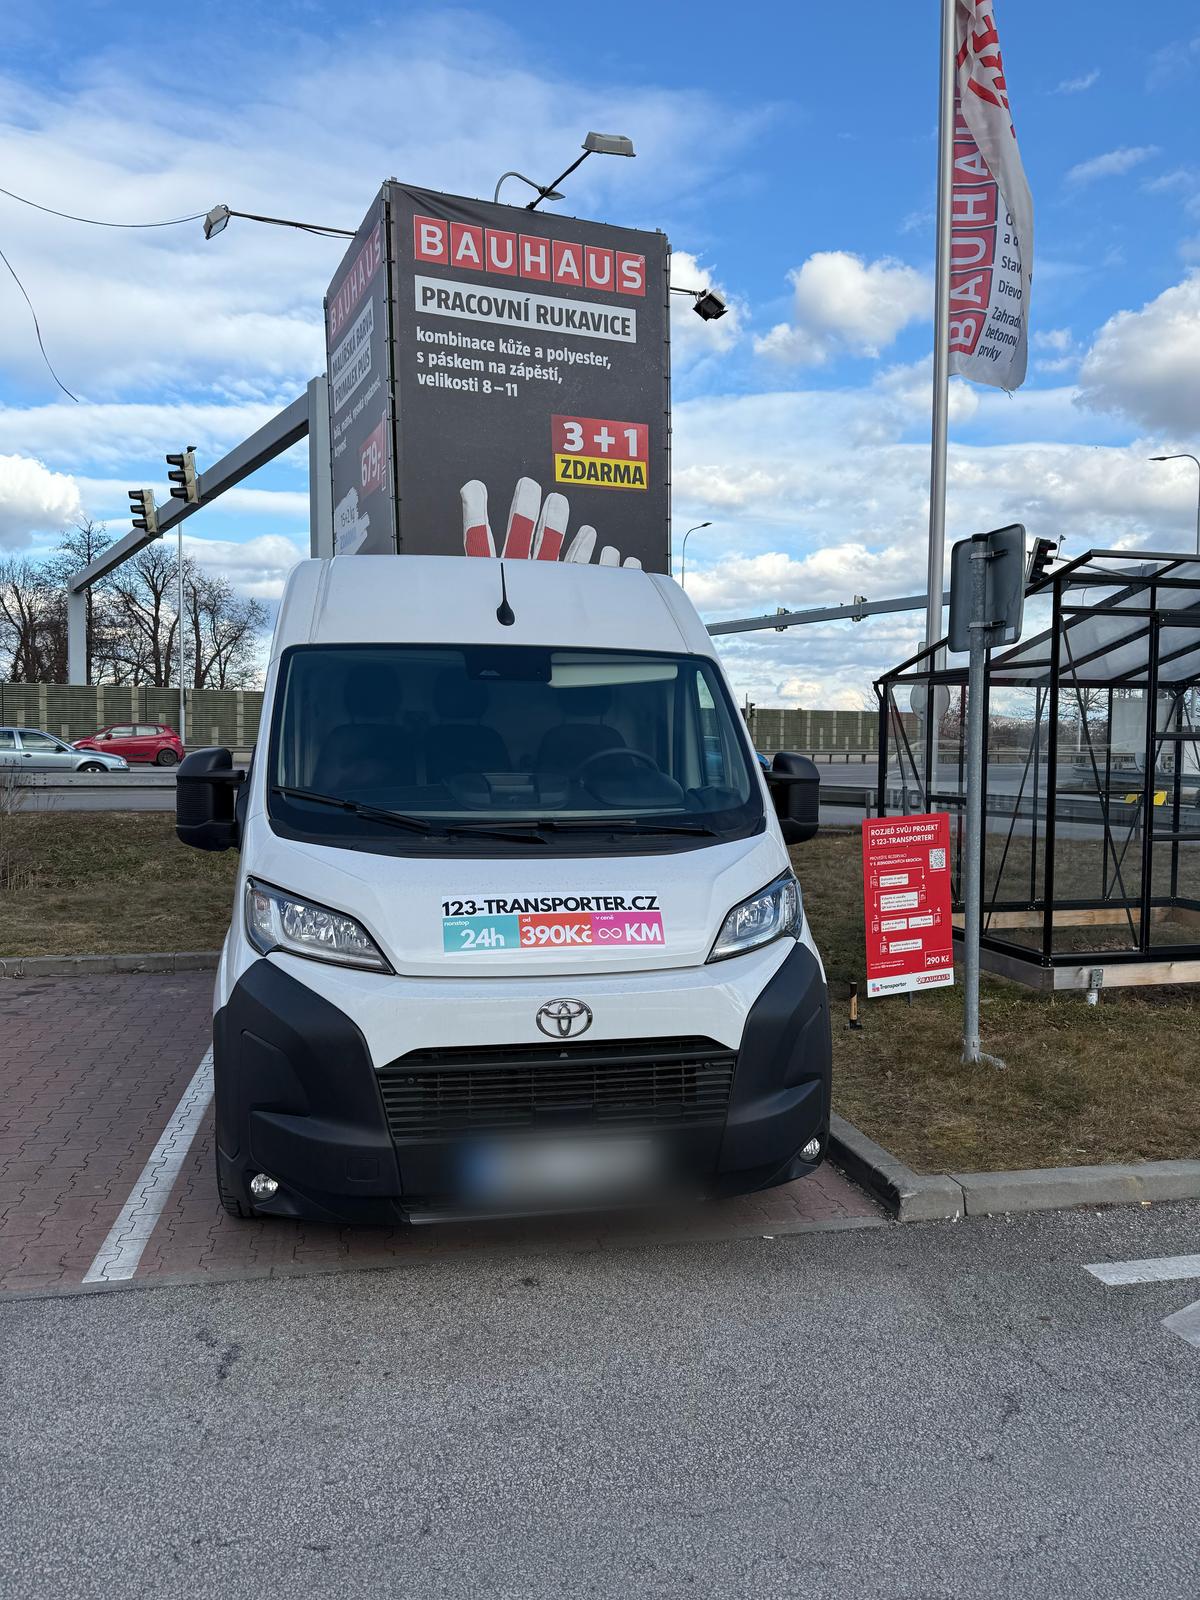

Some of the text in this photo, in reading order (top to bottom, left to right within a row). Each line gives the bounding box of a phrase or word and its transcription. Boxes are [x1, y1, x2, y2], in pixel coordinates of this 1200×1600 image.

[949, 106, 988, 347] BAUHA
[1003, 233, 1010, 245] a
[420, 223, 643, 289] BAUHAUS
[1001, 255, 1022, 274] Stav
[331, 227, 381, 336] BAUHAUS
[421, 286, 631, 336] PRACOVNÍ RUKAVICE
[356, 309, 373, 349] BARVA
[416, 326, 612, 370] kombinace kůže a polyester,
[977, 343, 1002, 363] prvky
[416, 352, 563, 385] s páskem na zápěstí,
[417, 372, 479, 393] velikosti
[562, 421, 585, 452] 3
[623, 428, 638, 457] 1
[560, 458, 645, 485] ZDARMA
[870, 824, 939, 836] ROZJEĎ SVŮJ PROJEKT
[877, 834, 934, 845] 123-TRANSPORTER!
[441, 895, 660, 917] 123-TRANSPORTER.CZ
[444, 919, 470, 927] nonstop
[625, 923, 662, 943] KM
[459, 928, 505, 949] 24h
[521, 924, 593, 945] 390Kč
[926, 957, 939, 965] 290
